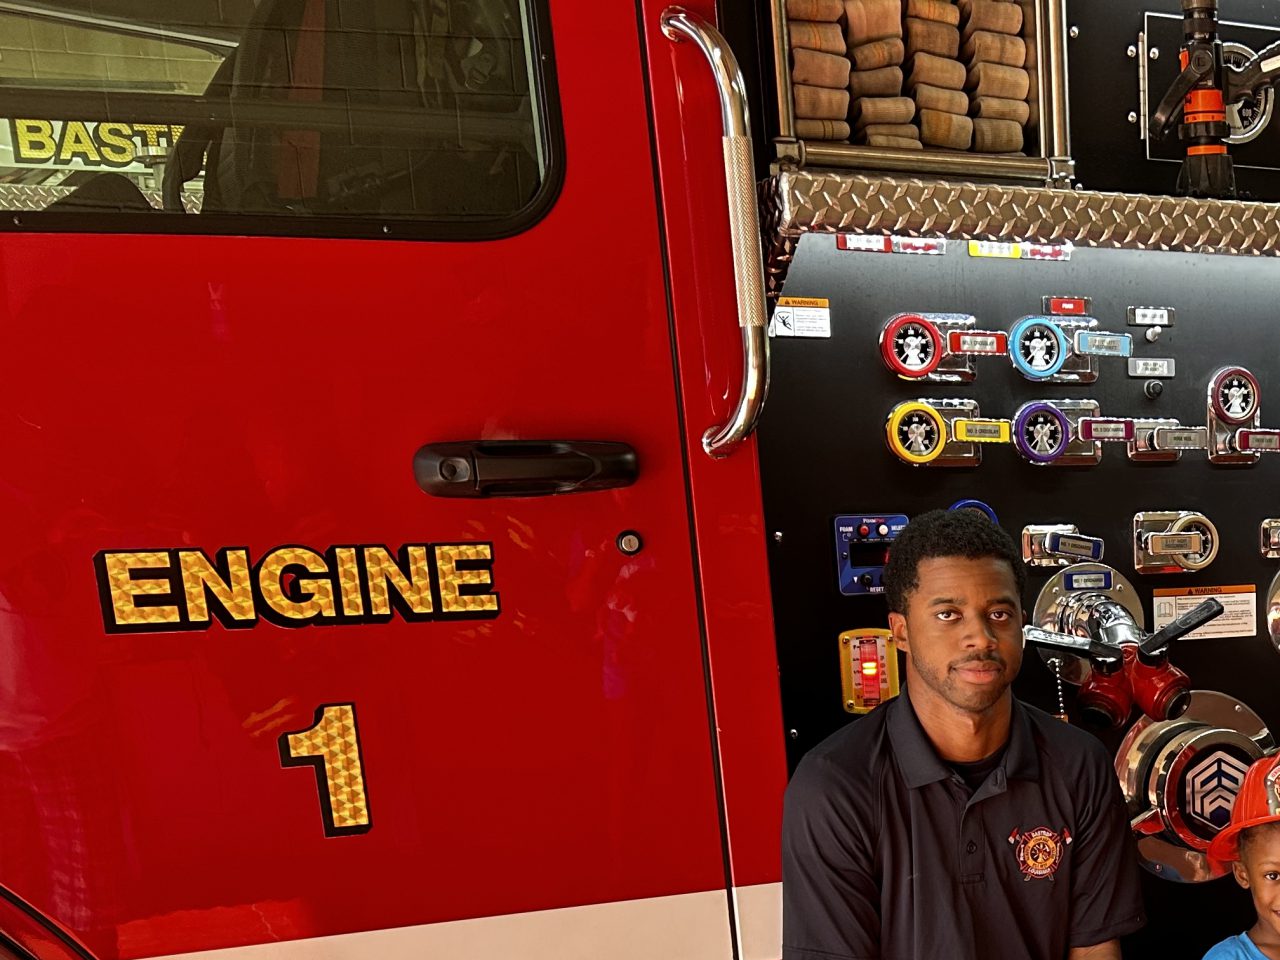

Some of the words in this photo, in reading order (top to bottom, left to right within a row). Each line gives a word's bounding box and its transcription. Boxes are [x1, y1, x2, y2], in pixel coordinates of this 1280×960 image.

[13, 117, 188, 168] BAST
[95, 541, 500, 633] ENGINE
[277, 702, 373, 838] 1
